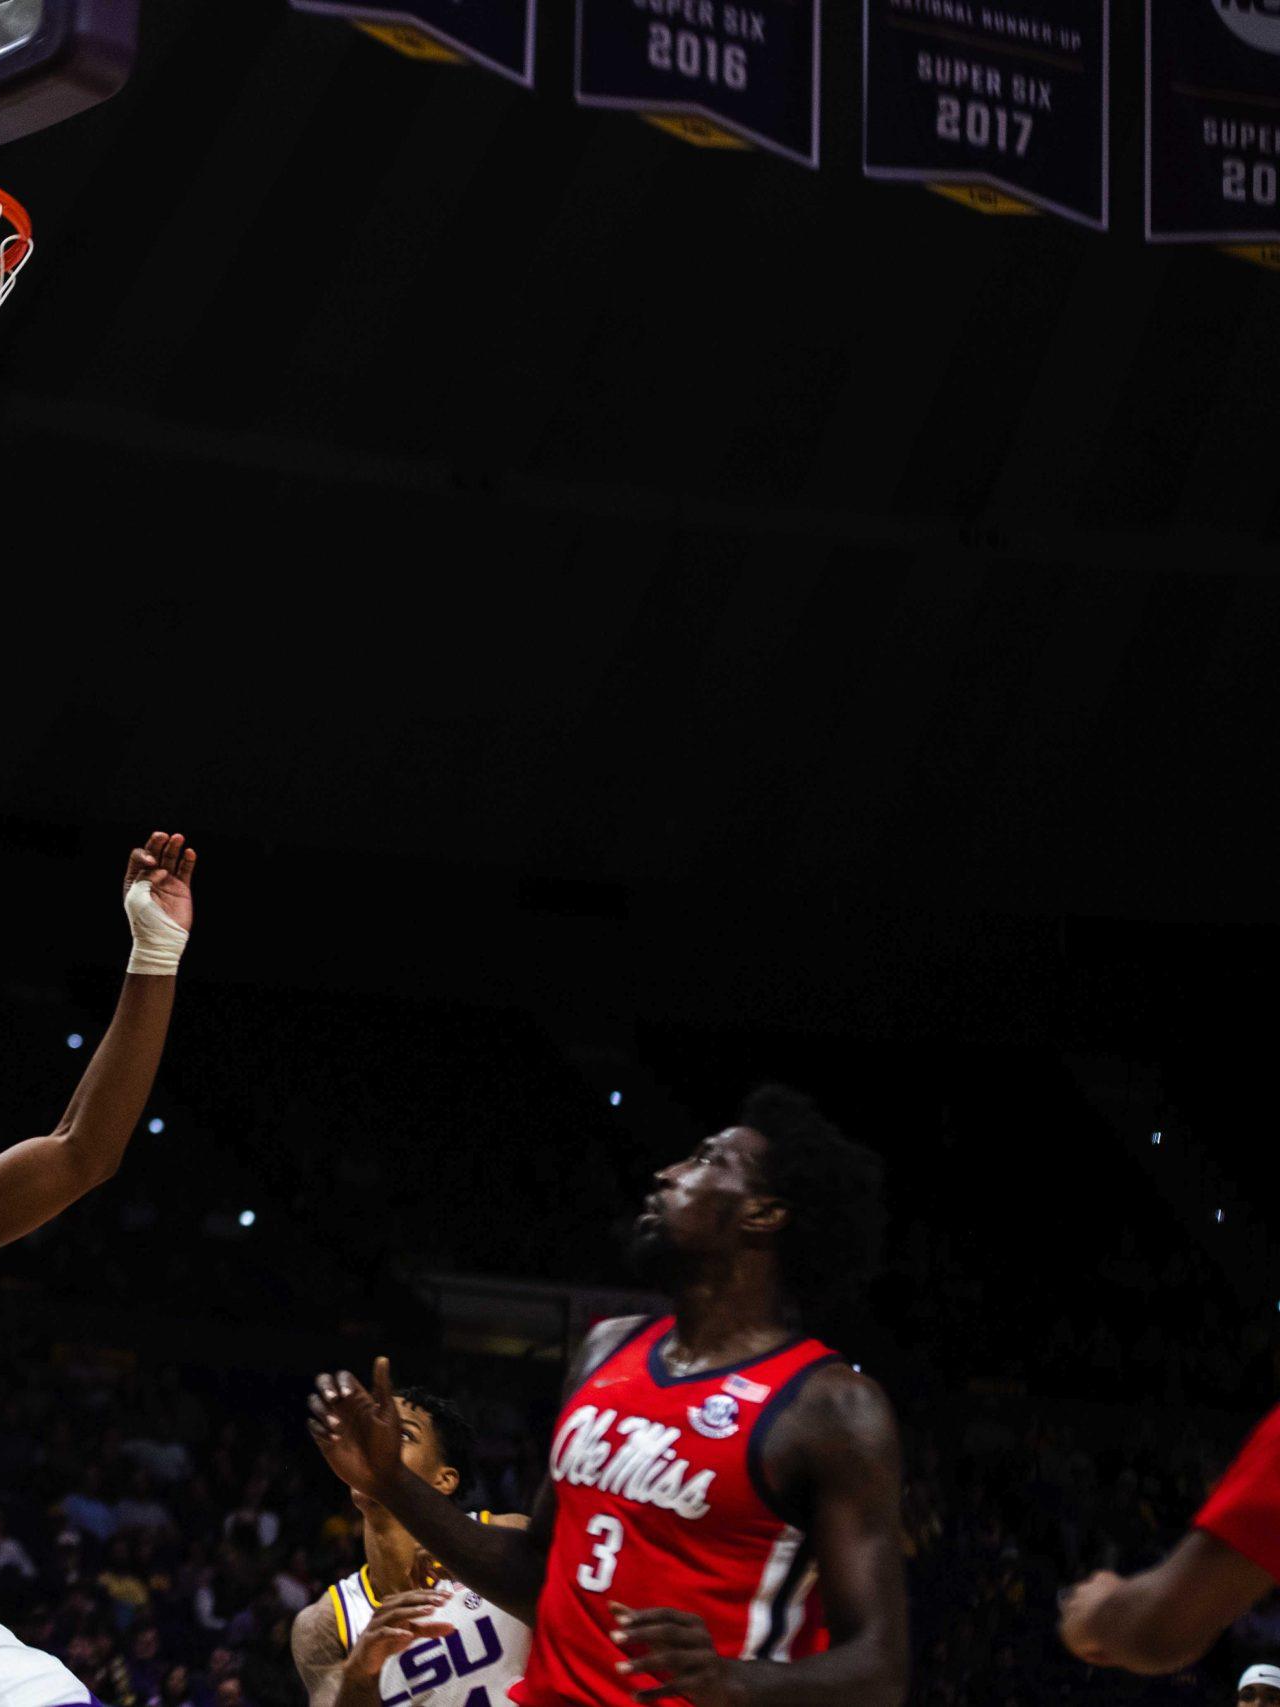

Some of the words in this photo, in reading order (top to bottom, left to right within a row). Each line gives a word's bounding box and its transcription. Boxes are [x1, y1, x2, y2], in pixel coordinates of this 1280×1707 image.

[647, 20, 749, 92] 2016
[916, 49, 1002, 98] SUPER
[1011, 72, 1052, 111] SIX
[935, 93, 1034, 158] 2017
[1203, 114, 1280, 155] SUPE
[549, 1404, 618, 1488] Ole
[598, 1415, 717, 1520] Miss
[576, 1513, 624, 1593] 3
